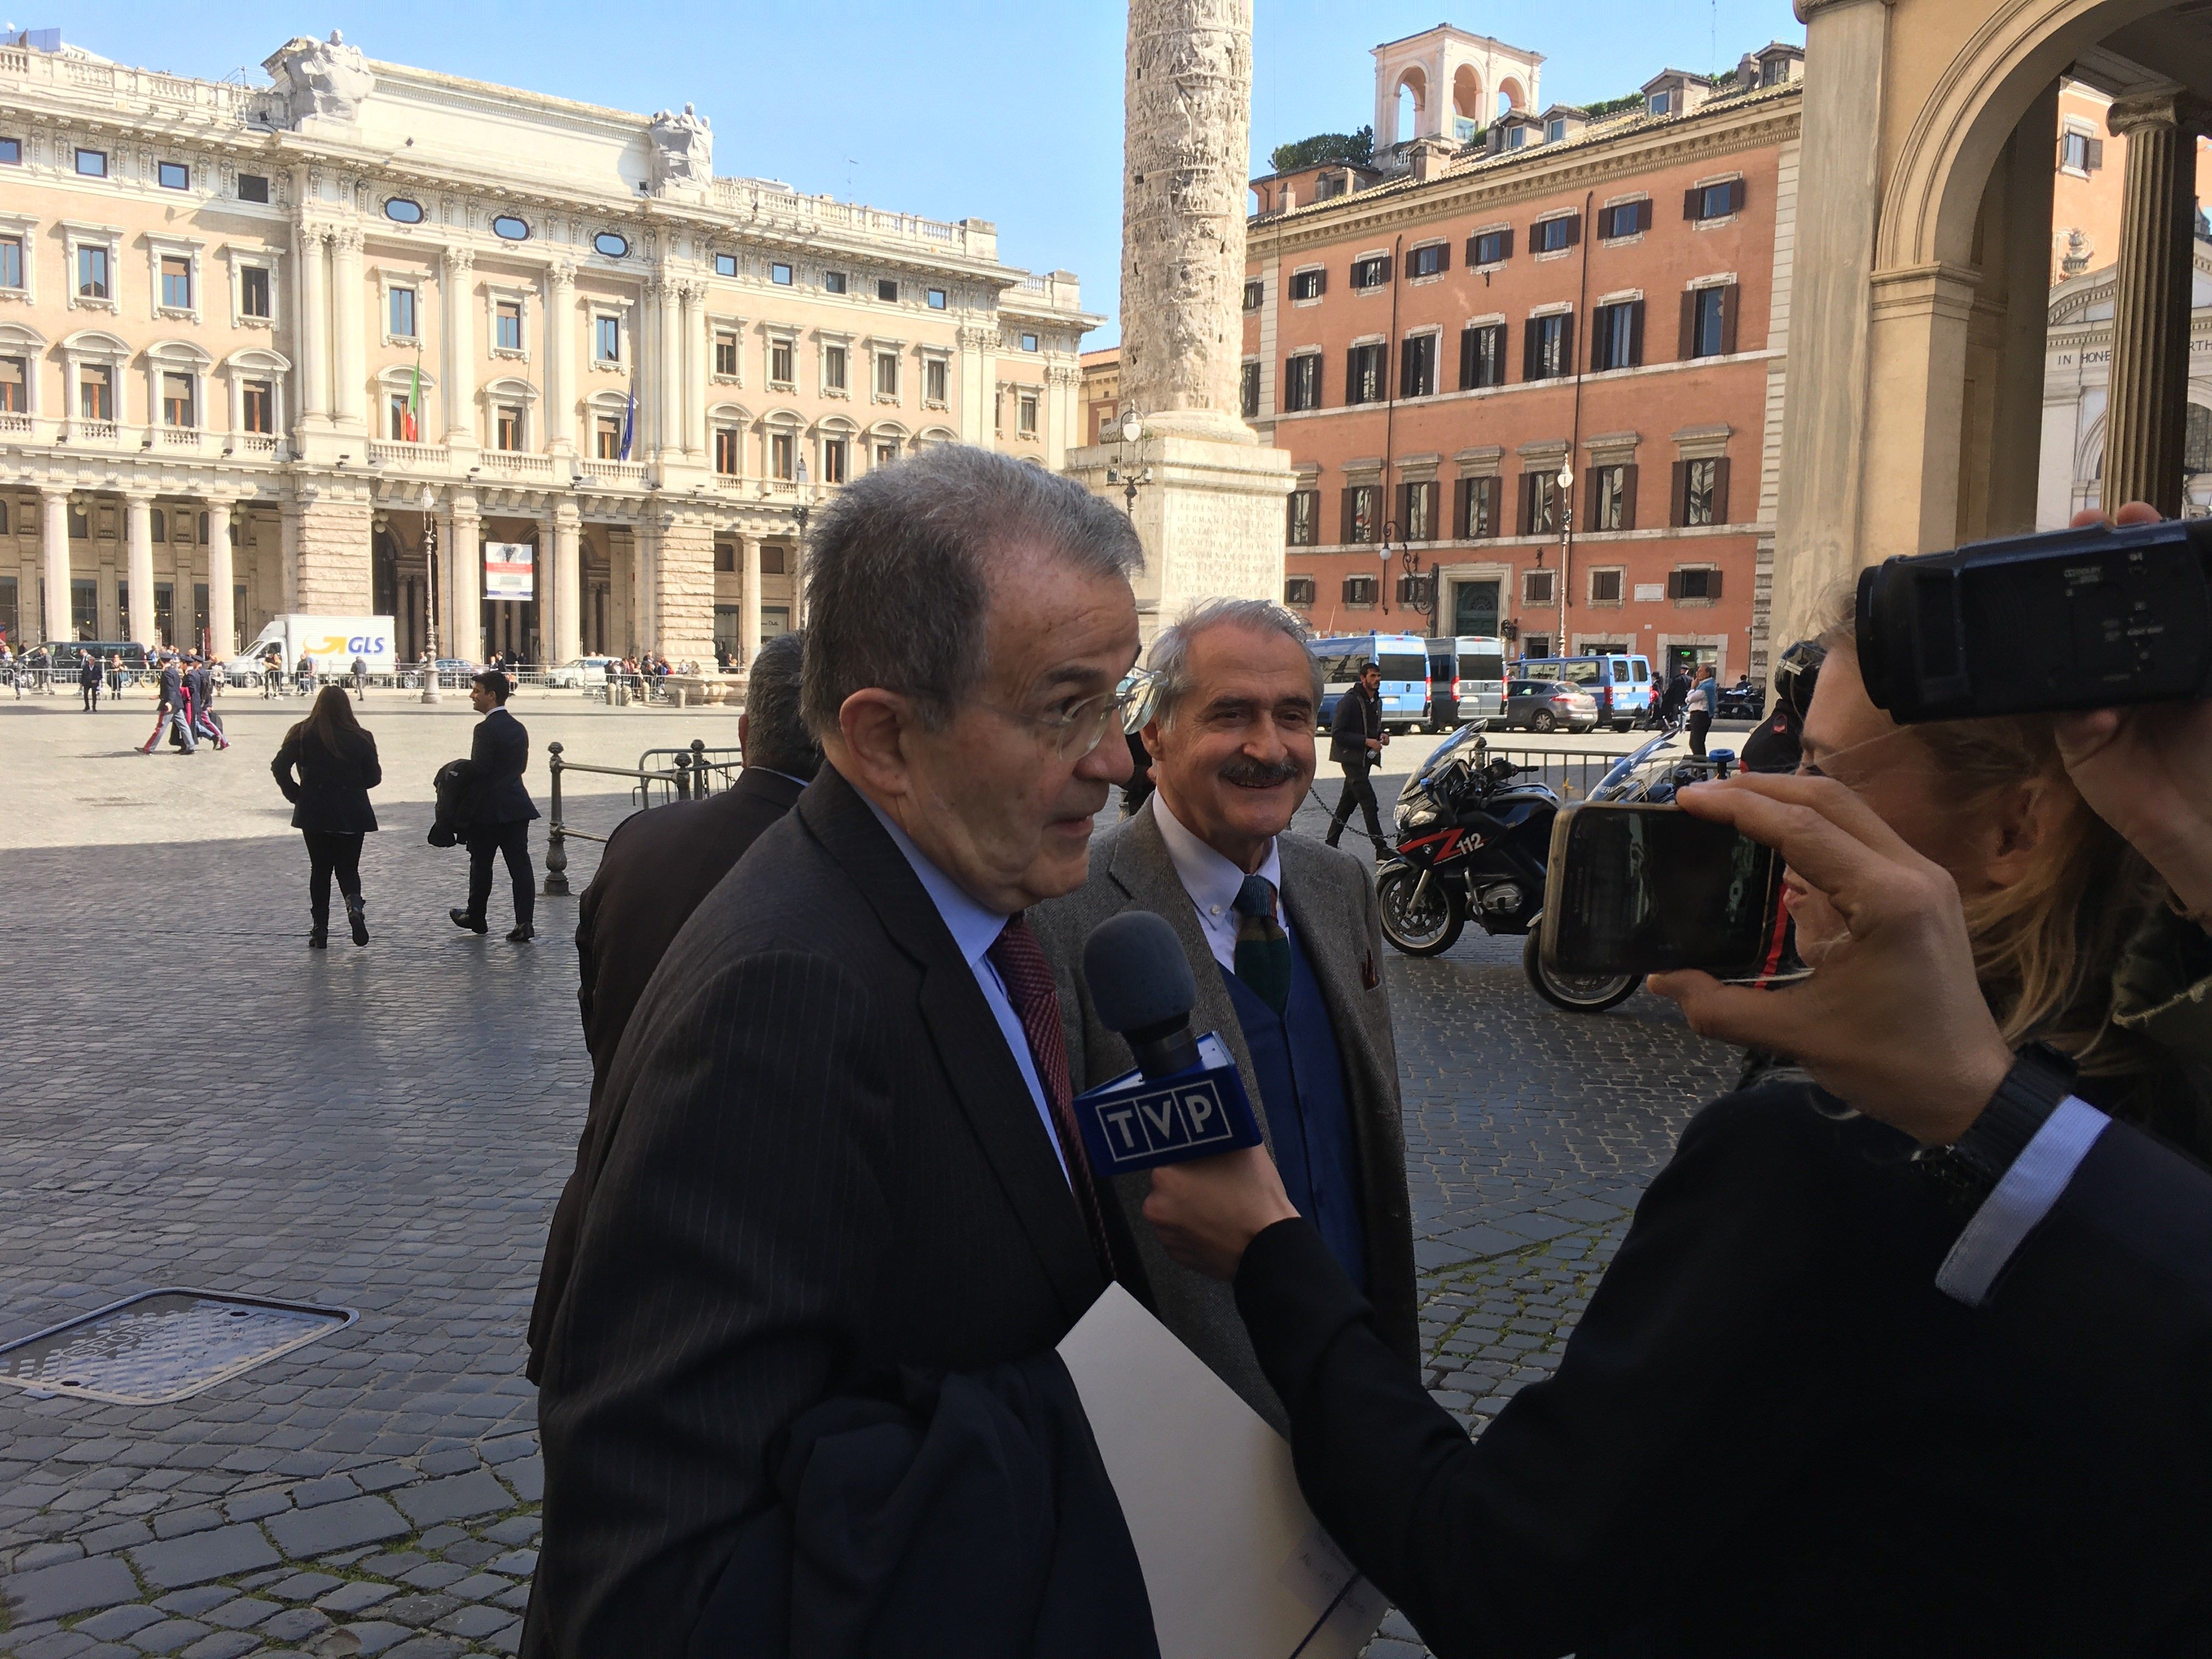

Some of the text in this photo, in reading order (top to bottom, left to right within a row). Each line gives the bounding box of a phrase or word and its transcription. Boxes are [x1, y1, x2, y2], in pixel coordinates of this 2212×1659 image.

[2058, 355, 2072, 365] IN
[348, 636, 385, 654] GLS
[1457, 833, 1484, 855] 112
[1106, 1094, 1212, 1148] TVP
